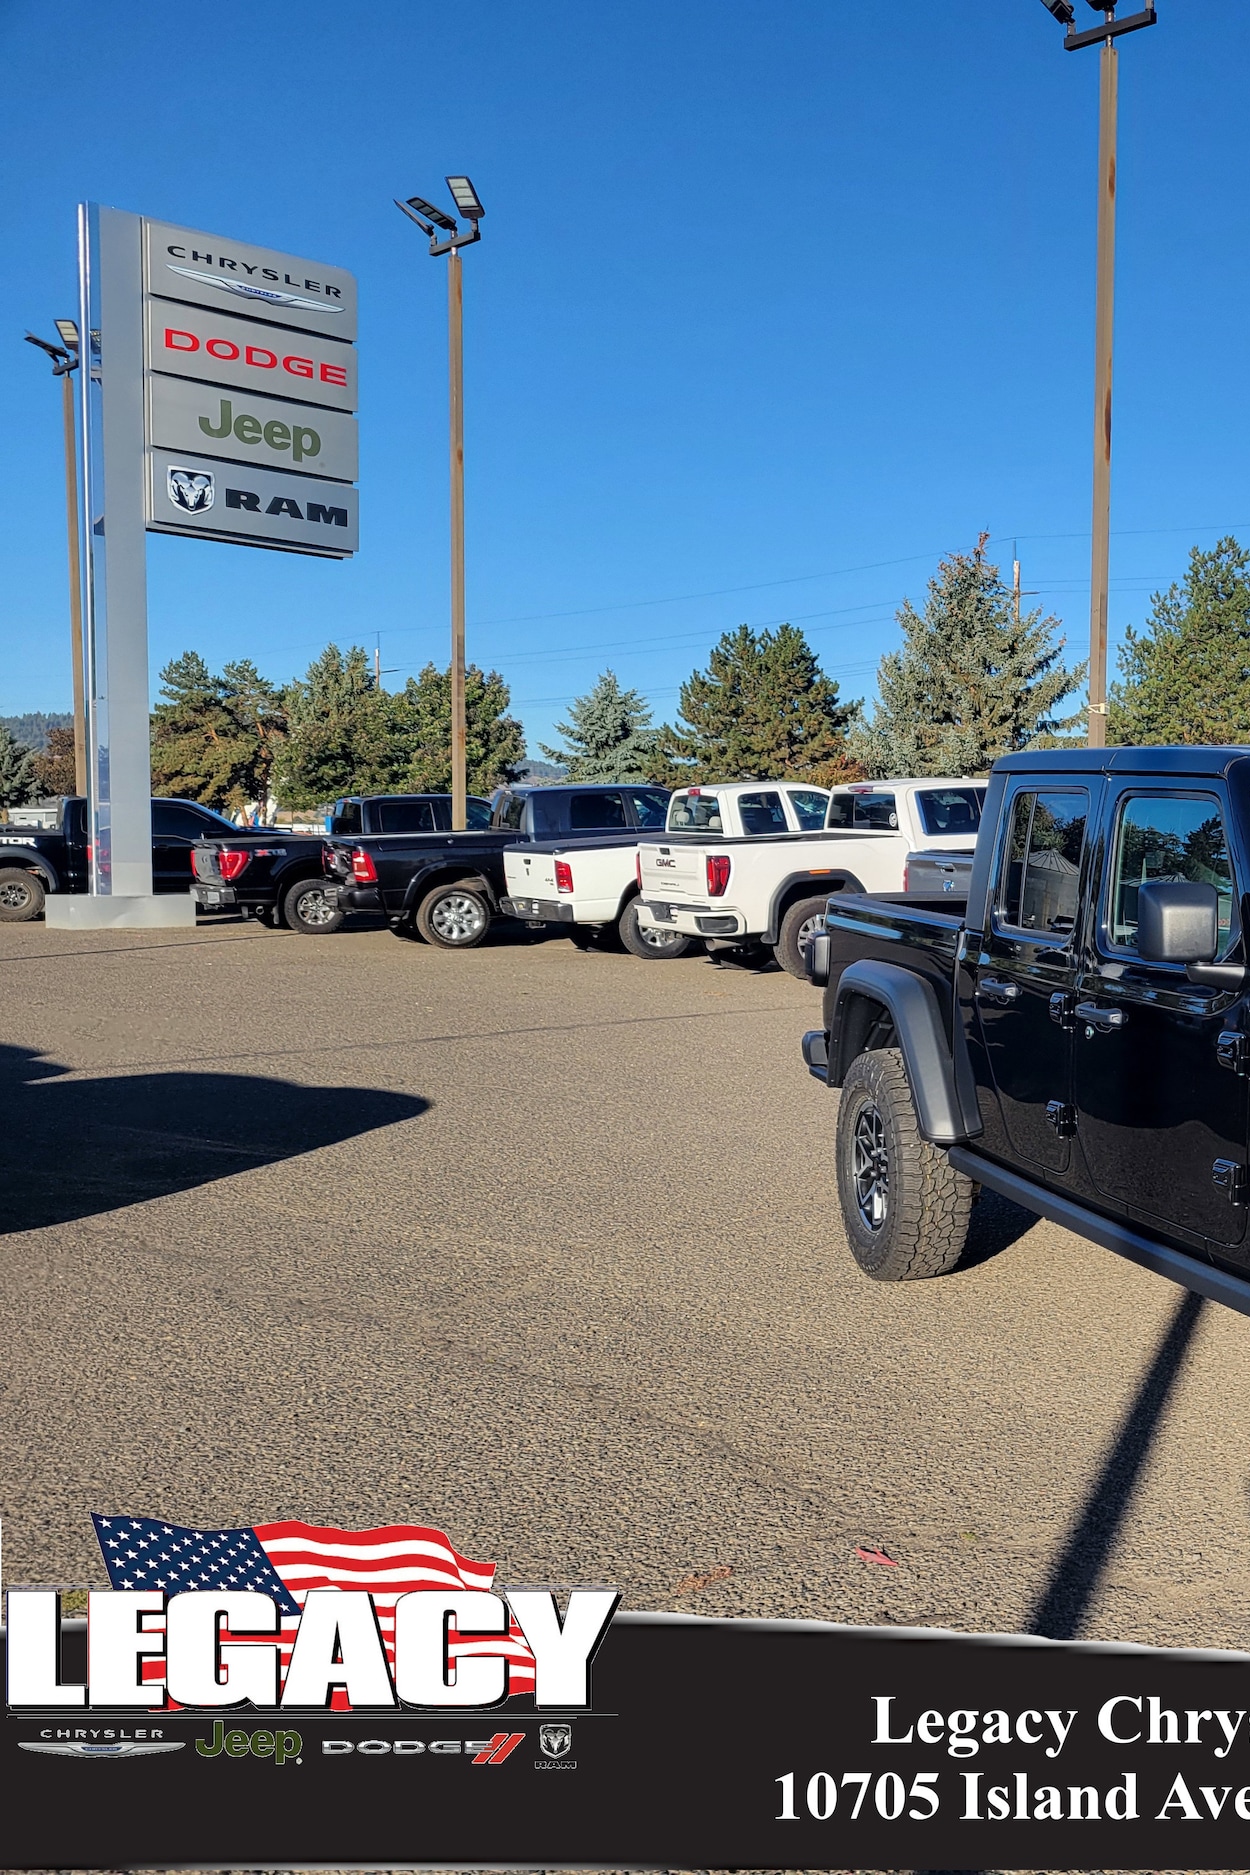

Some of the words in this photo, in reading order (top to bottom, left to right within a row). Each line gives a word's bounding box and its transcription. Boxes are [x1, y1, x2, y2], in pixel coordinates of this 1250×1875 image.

[167, 245, 342, 299] CHRYSLER
[164, 328, 347, 387] DODGE
[198, 399, 321, 462] Jeep
[225, 488, 348, 527] RAM
[656, 858, 676, 868] GMC
